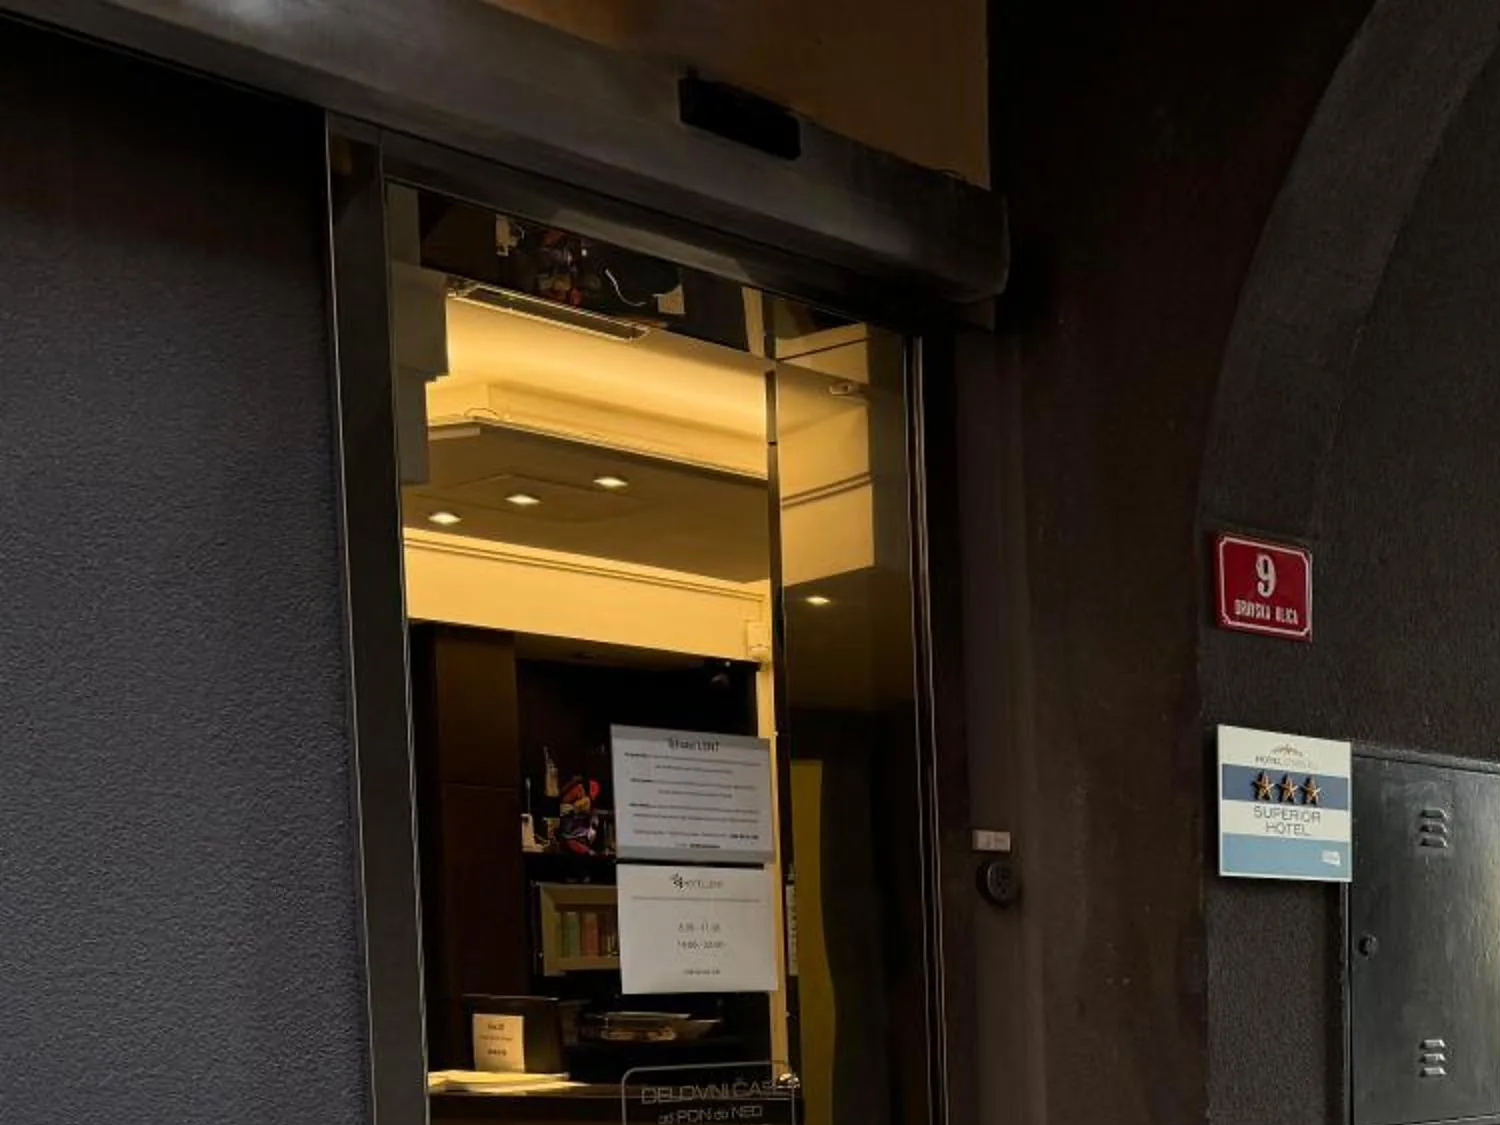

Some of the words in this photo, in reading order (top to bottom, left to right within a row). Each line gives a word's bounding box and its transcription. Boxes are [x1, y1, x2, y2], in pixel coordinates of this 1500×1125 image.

[1255, 553, 1277, 598] 9
[1254, 805, 1321, 825] SUPERIOR
[1265, 821, 1311, 836] HOTEL
[641, 1083, 729, 1105] DELOVNI
[677, 1108, 712, 1124] PON
[731, 1105, 763, 1119] NED
